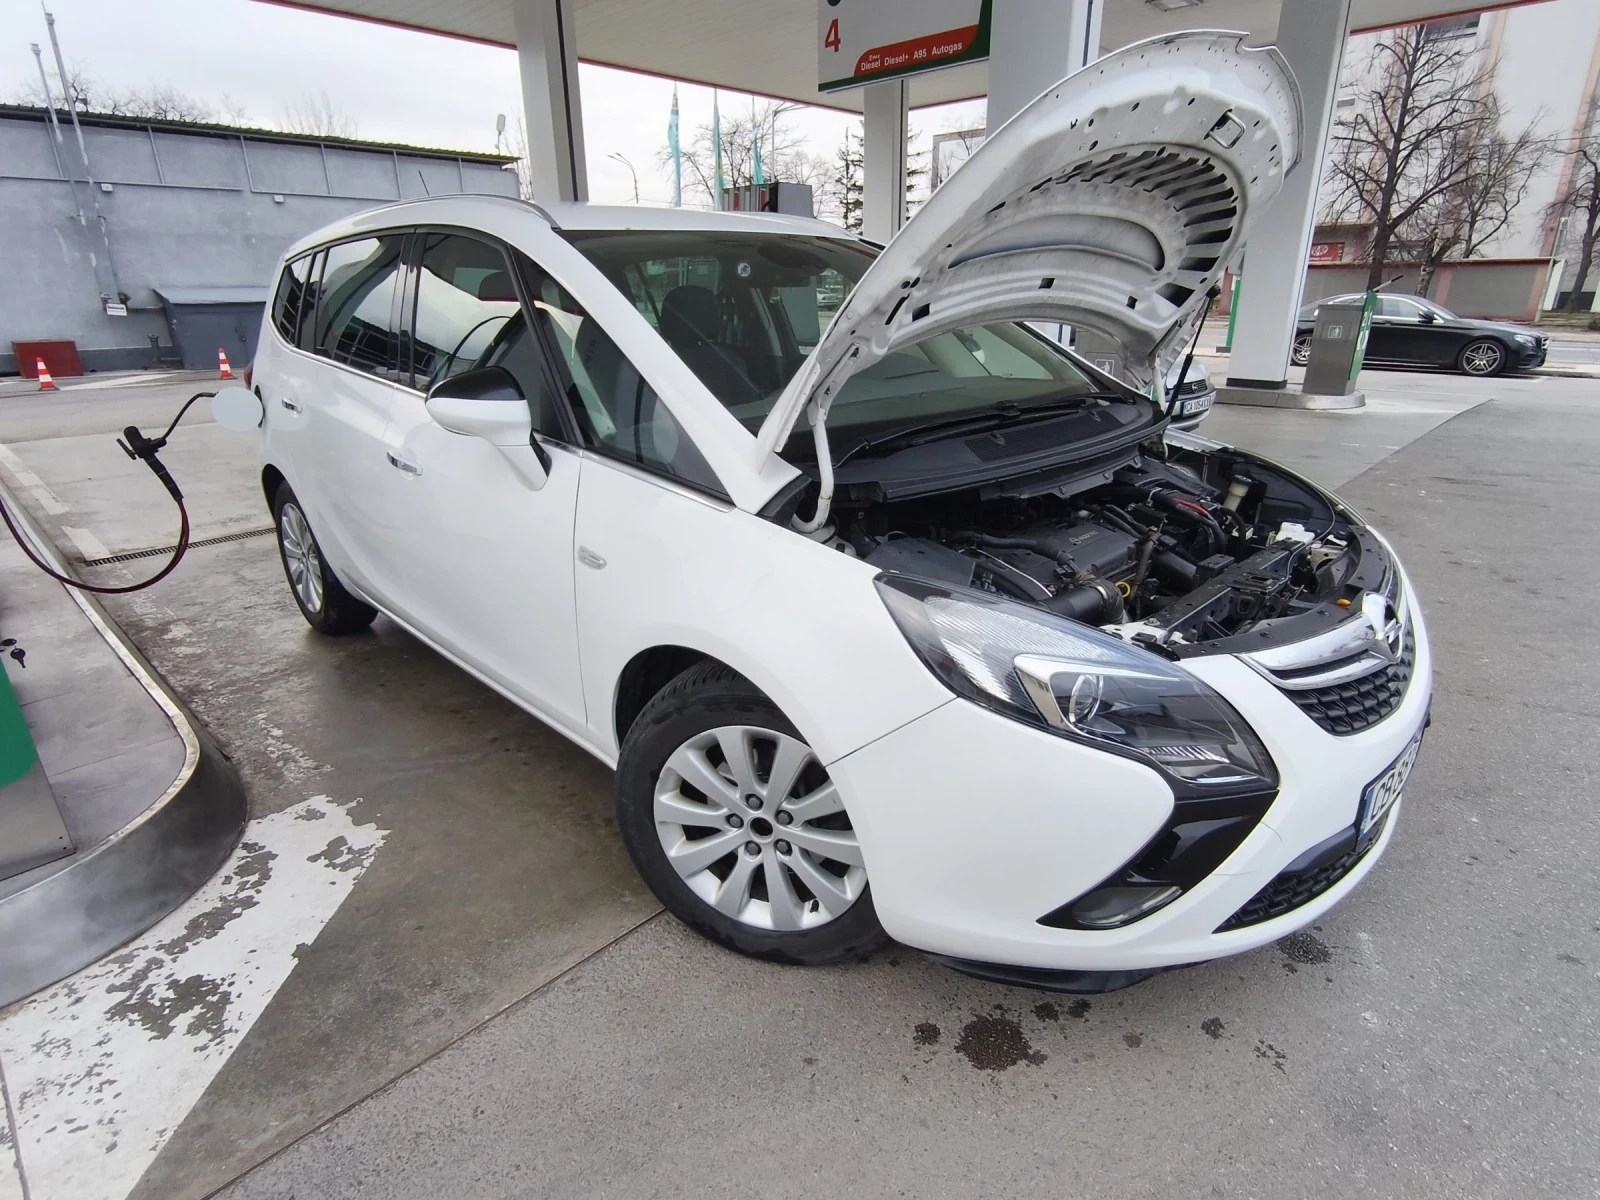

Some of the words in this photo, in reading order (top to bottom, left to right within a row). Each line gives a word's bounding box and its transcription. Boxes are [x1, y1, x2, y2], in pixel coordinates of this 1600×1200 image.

[824, 18, 841, 52] 4
[861, 59, 881, 71] Diesel
[884, 53, 909, 66] Diesel+
[913, 48, 927, 60] A95
[931, 41, 963, 57] Autogas
